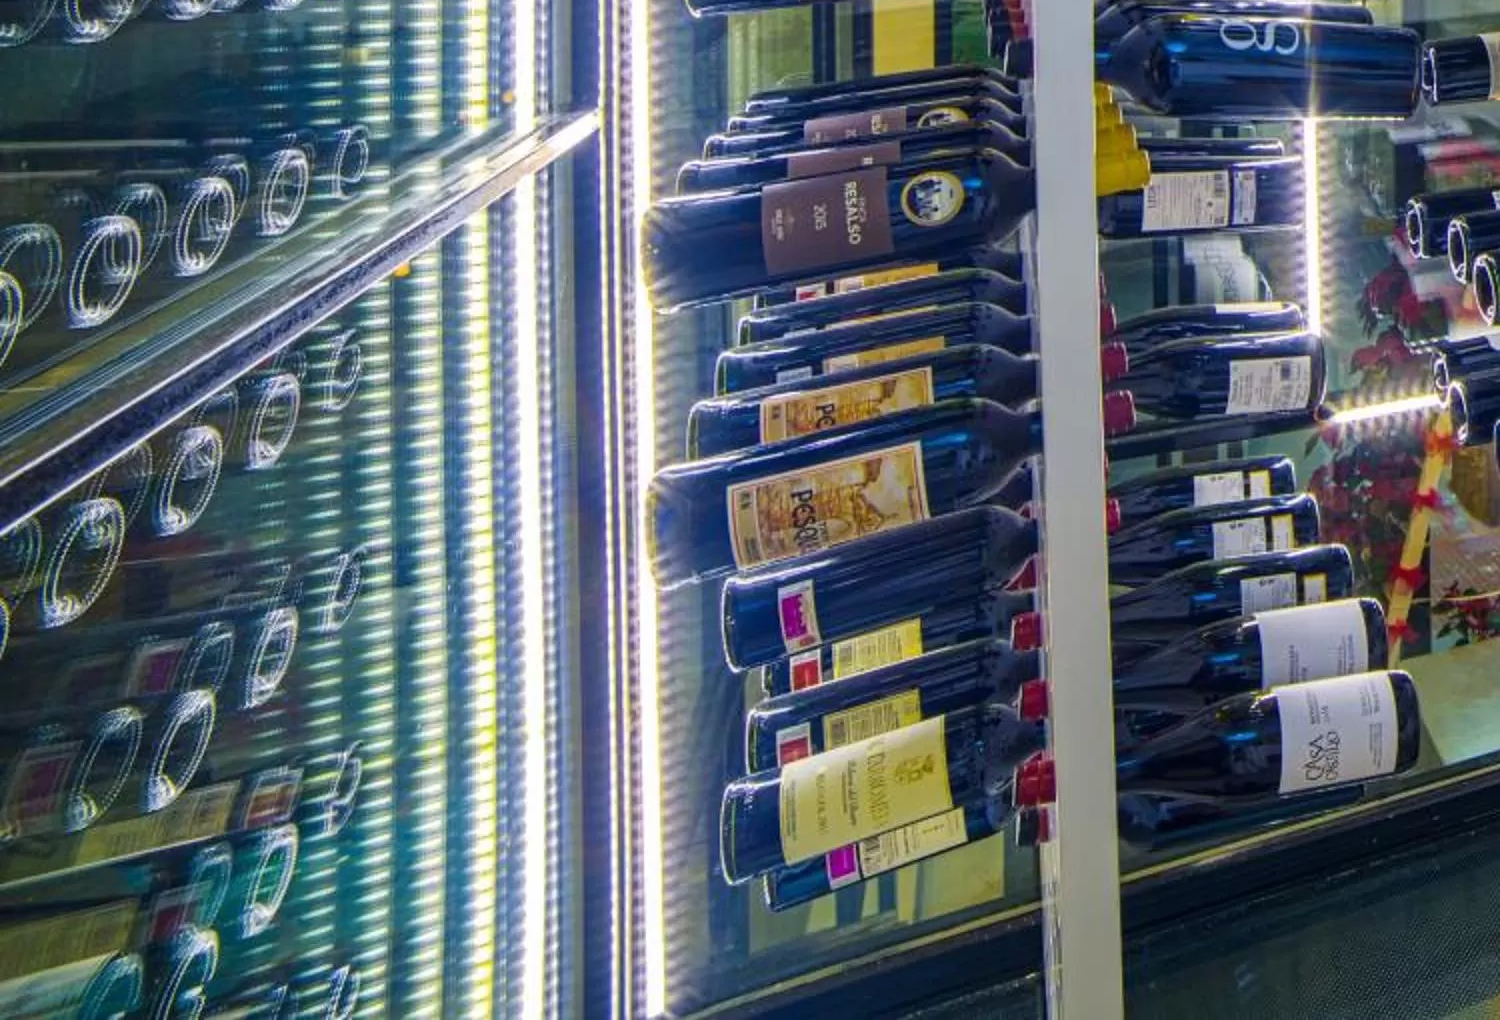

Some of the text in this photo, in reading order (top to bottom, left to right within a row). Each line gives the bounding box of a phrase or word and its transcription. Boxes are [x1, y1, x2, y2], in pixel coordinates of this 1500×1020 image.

[844, 180, 861, 245] RESALSO
[791, 489, 816, 551] PESQU
[1304, 734, 1325, 781] CASA
